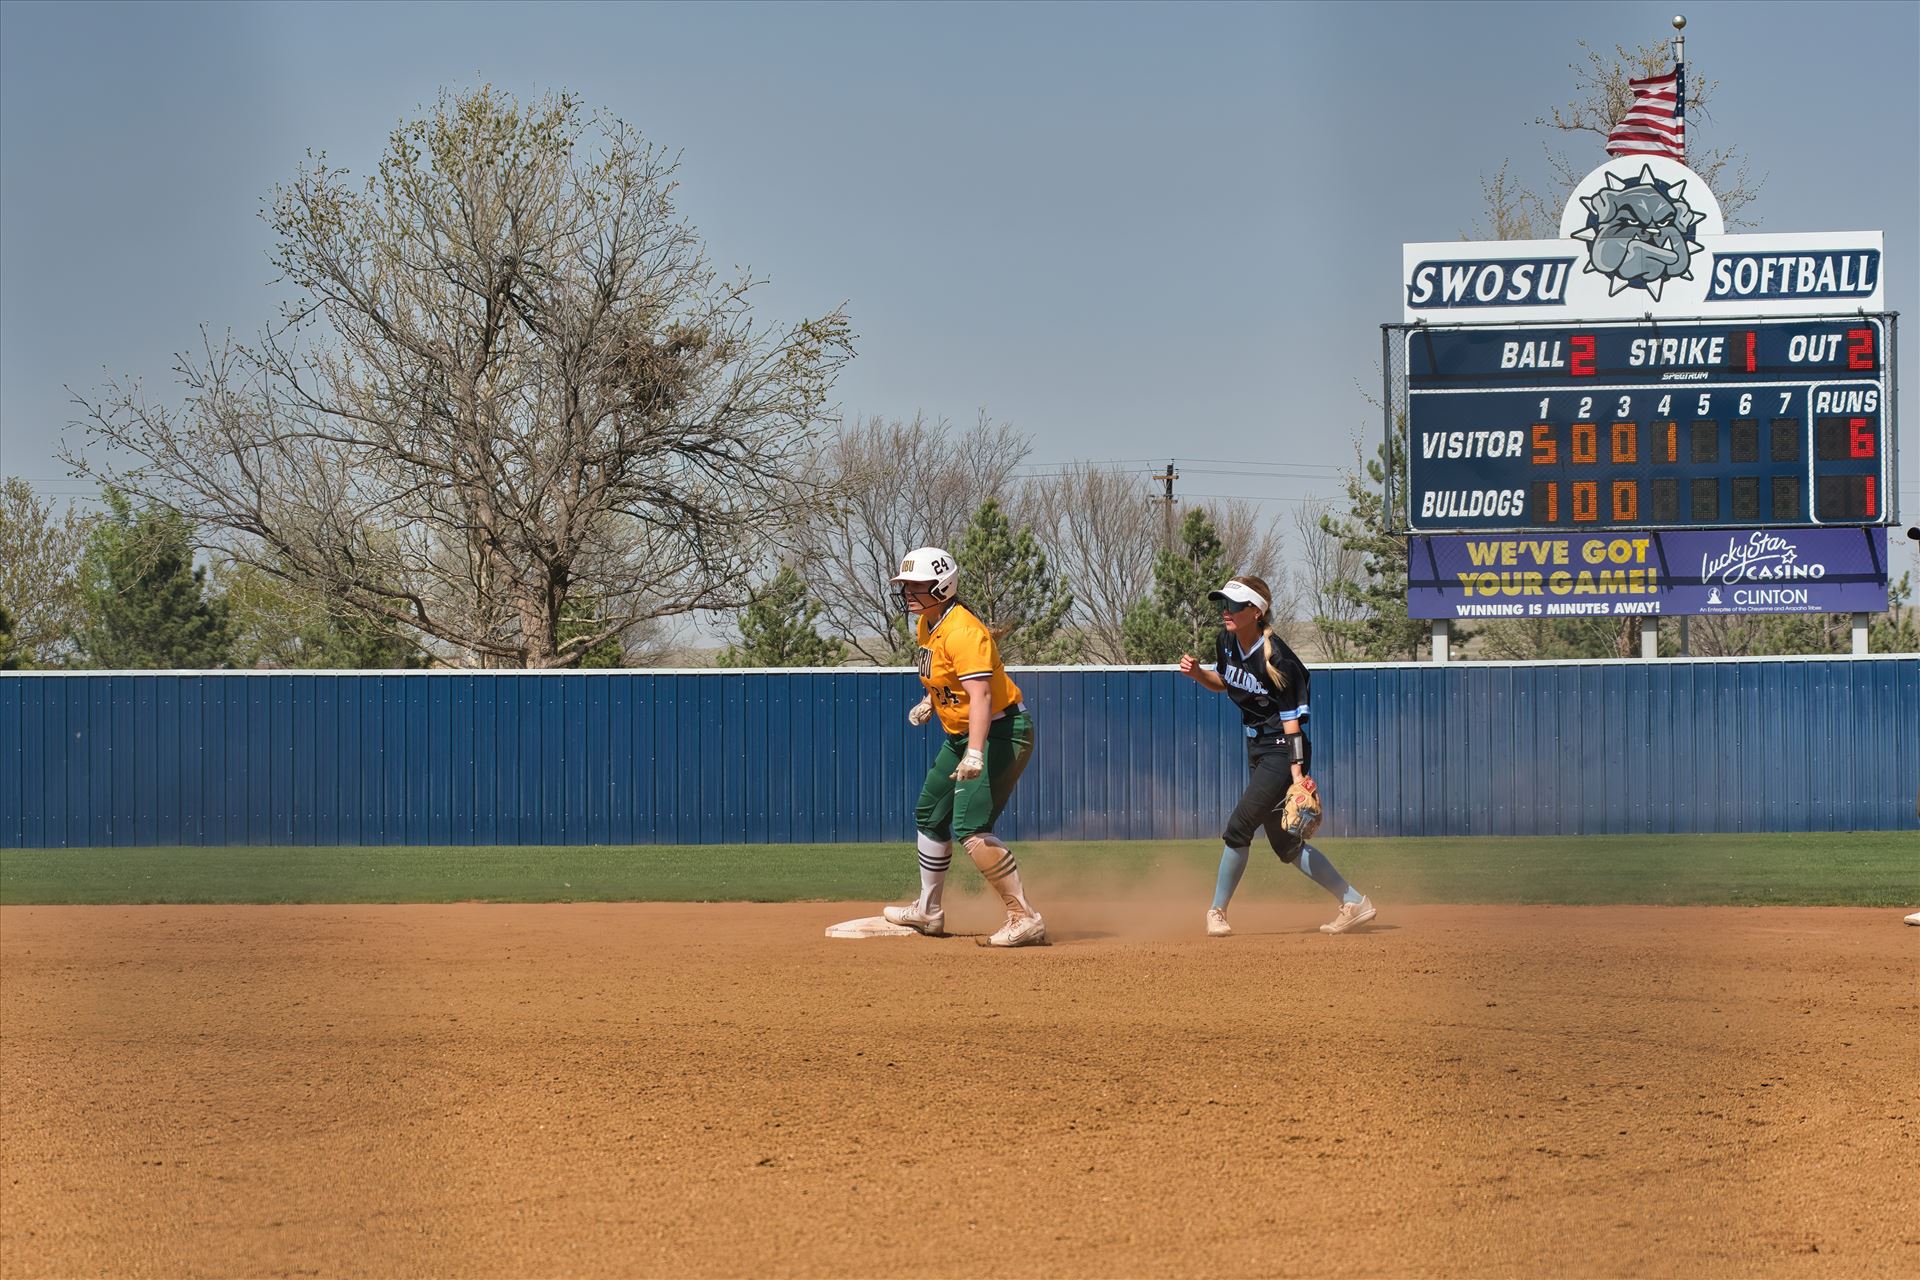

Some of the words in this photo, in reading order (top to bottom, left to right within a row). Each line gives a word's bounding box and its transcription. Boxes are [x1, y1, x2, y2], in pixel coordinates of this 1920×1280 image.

[1411, 263, 1568, 303] SWOSU
[1714, 255, 1874, 296] SOFTBALL
[1500, 341, 1565, 369] BALL
[1571, 335, 1596, 376] 2
[1629, 336, 1725, 366] STRIKE
[1746, 331, 1756, 372] 1
[1788, 334, 1843, 363] OUT
[1847, 329, 1873, 369] 2
[1661, 371, 1709, 381] SPECTRUM
[1539, 397, 1550, 419] 1
[1578, 396, 1593, 419] 2
[1617, 395, 1631, 418] 3
[1657, 394, 1672, 416] 4
[1697, 393, 1712, 416] 5
[1738, 393, 1753, 416] 6
[1779, 392, 1792, 414] 7
[1816, 390, 1879, 413] RUNS
[1422, 430, 1525, 459] VISITOR
[1532, 425, 1557, 464] 5
[1572, 424, 1597, 463] 0
[1612, 423, 1637, 463] 0
[1667, 422, 1677, 462] 1
[1850, 418, 1875, 458] 6
[1421, 489, 1525, 518] BULLDOGS
[1548, 482, 1558, 522] 1
[1573, 482, 1597, 521] 0
[1613, 481, 1637, 521] 0
[1866, 476, 1875, 516] 1
[931, 556, 950, 576] 24
[1466, 540, 1569, 566] WE'VE
[1582, 539, 1650, 565] GOT
[1456, 571, 1545, 597] YOUR
[1549, 568, 1658, 596] GAME!
[1746, 563, 1825, 580] CASINO
[1456, 604, 1524, 616] WINNING
[1528, 603, 1542, 615] IS
[1547, 602, 1610, 615] MINUTES
[1613, 601, 1661, 614] AWAY!
[1734, 588, 1808, 605] CLINTON
[931, 685, 960, 706] 24
